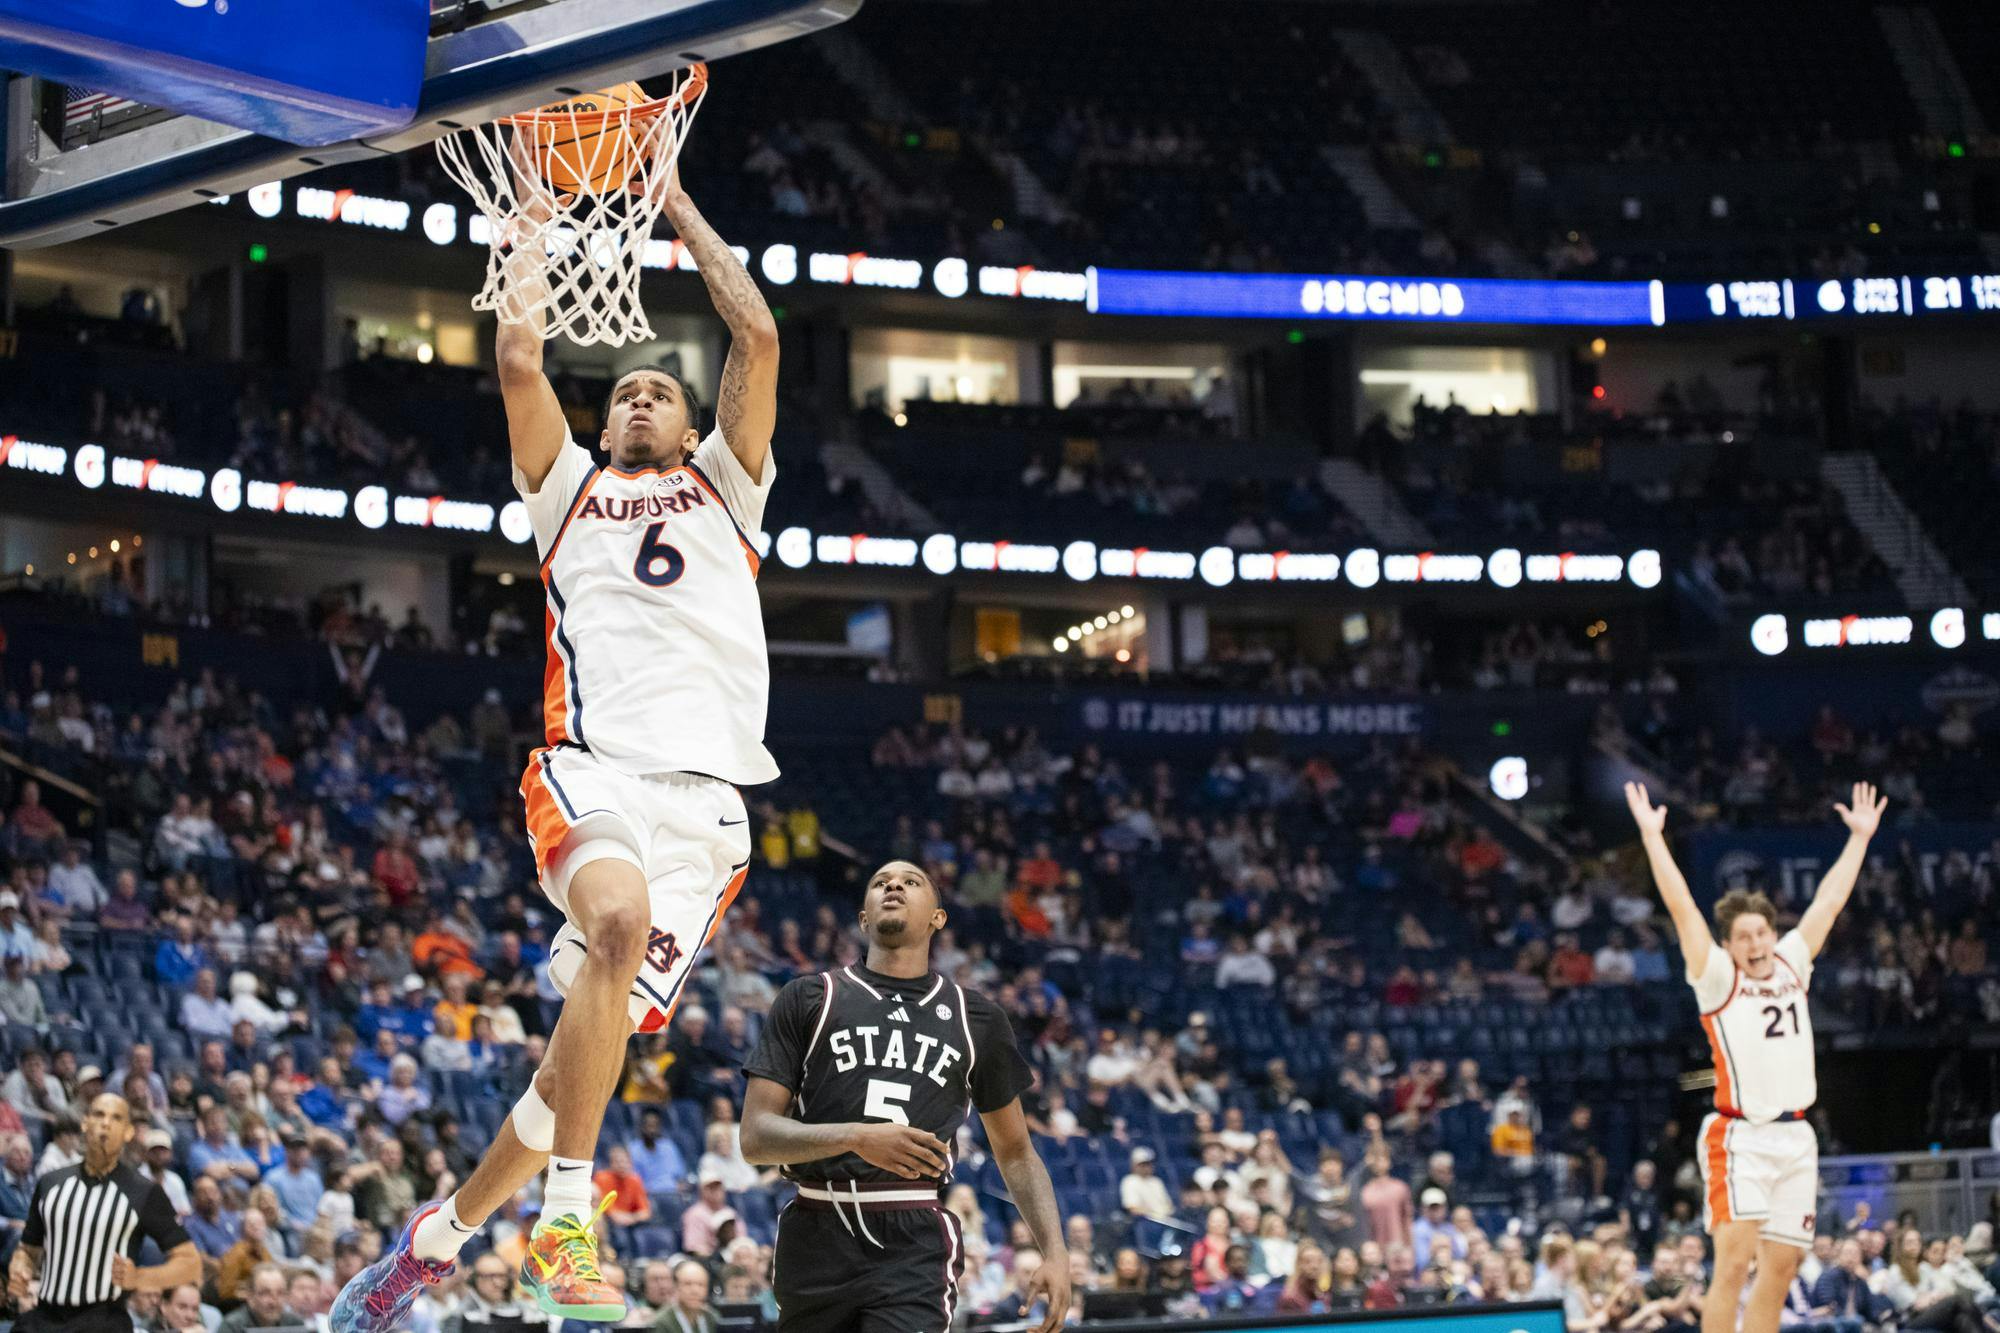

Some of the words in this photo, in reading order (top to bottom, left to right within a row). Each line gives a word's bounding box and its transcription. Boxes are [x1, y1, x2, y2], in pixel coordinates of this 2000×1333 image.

[577, 487, 706, 522] AUBURN
[633, 521, 685, 588] 6
[1149, 703, 1211, 733] JUST
[1762, 1003, 1799, 1038] 21
[829, 1026, 962, 1088] STATE
[863, 1078, 912, 1127] 5
